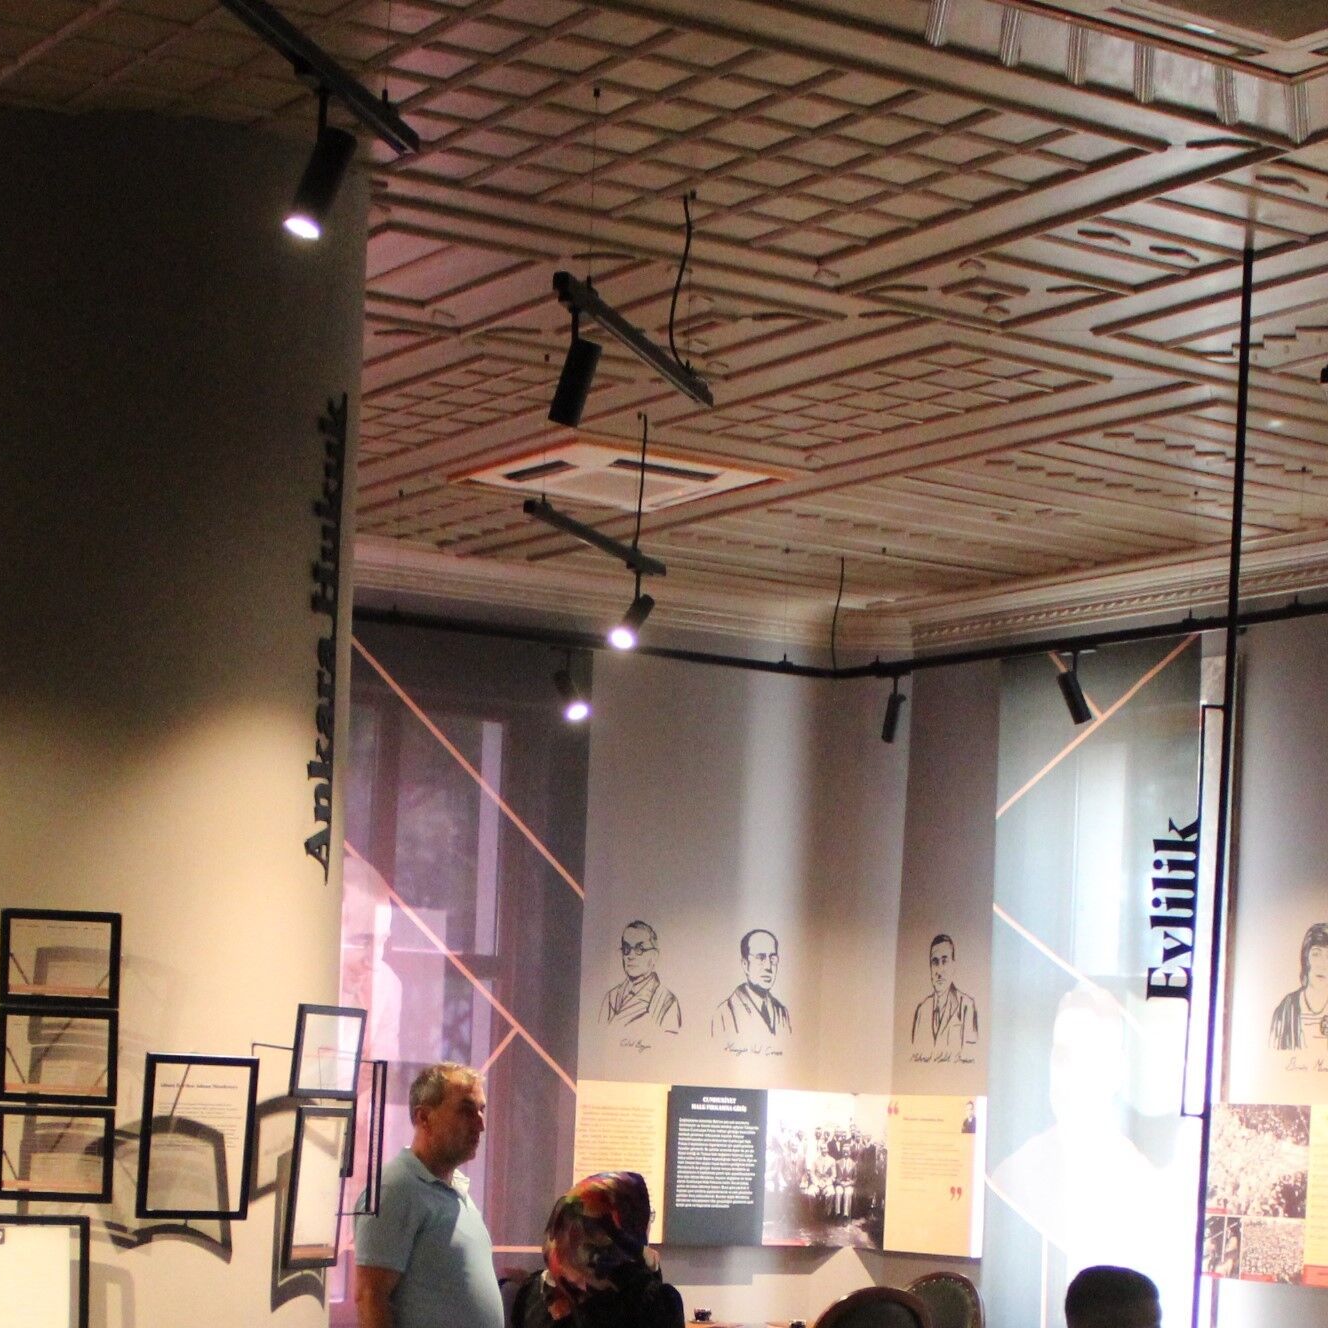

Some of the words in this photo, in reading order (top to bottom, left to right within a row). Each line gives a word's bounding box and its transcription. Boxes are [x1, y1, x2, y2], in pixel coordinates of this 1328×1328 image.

[312, 394, 347, 614] Hukuk
[304, 638, 336, 876] Ankara
[1146, 817, 1200, 1001] Evlilik
